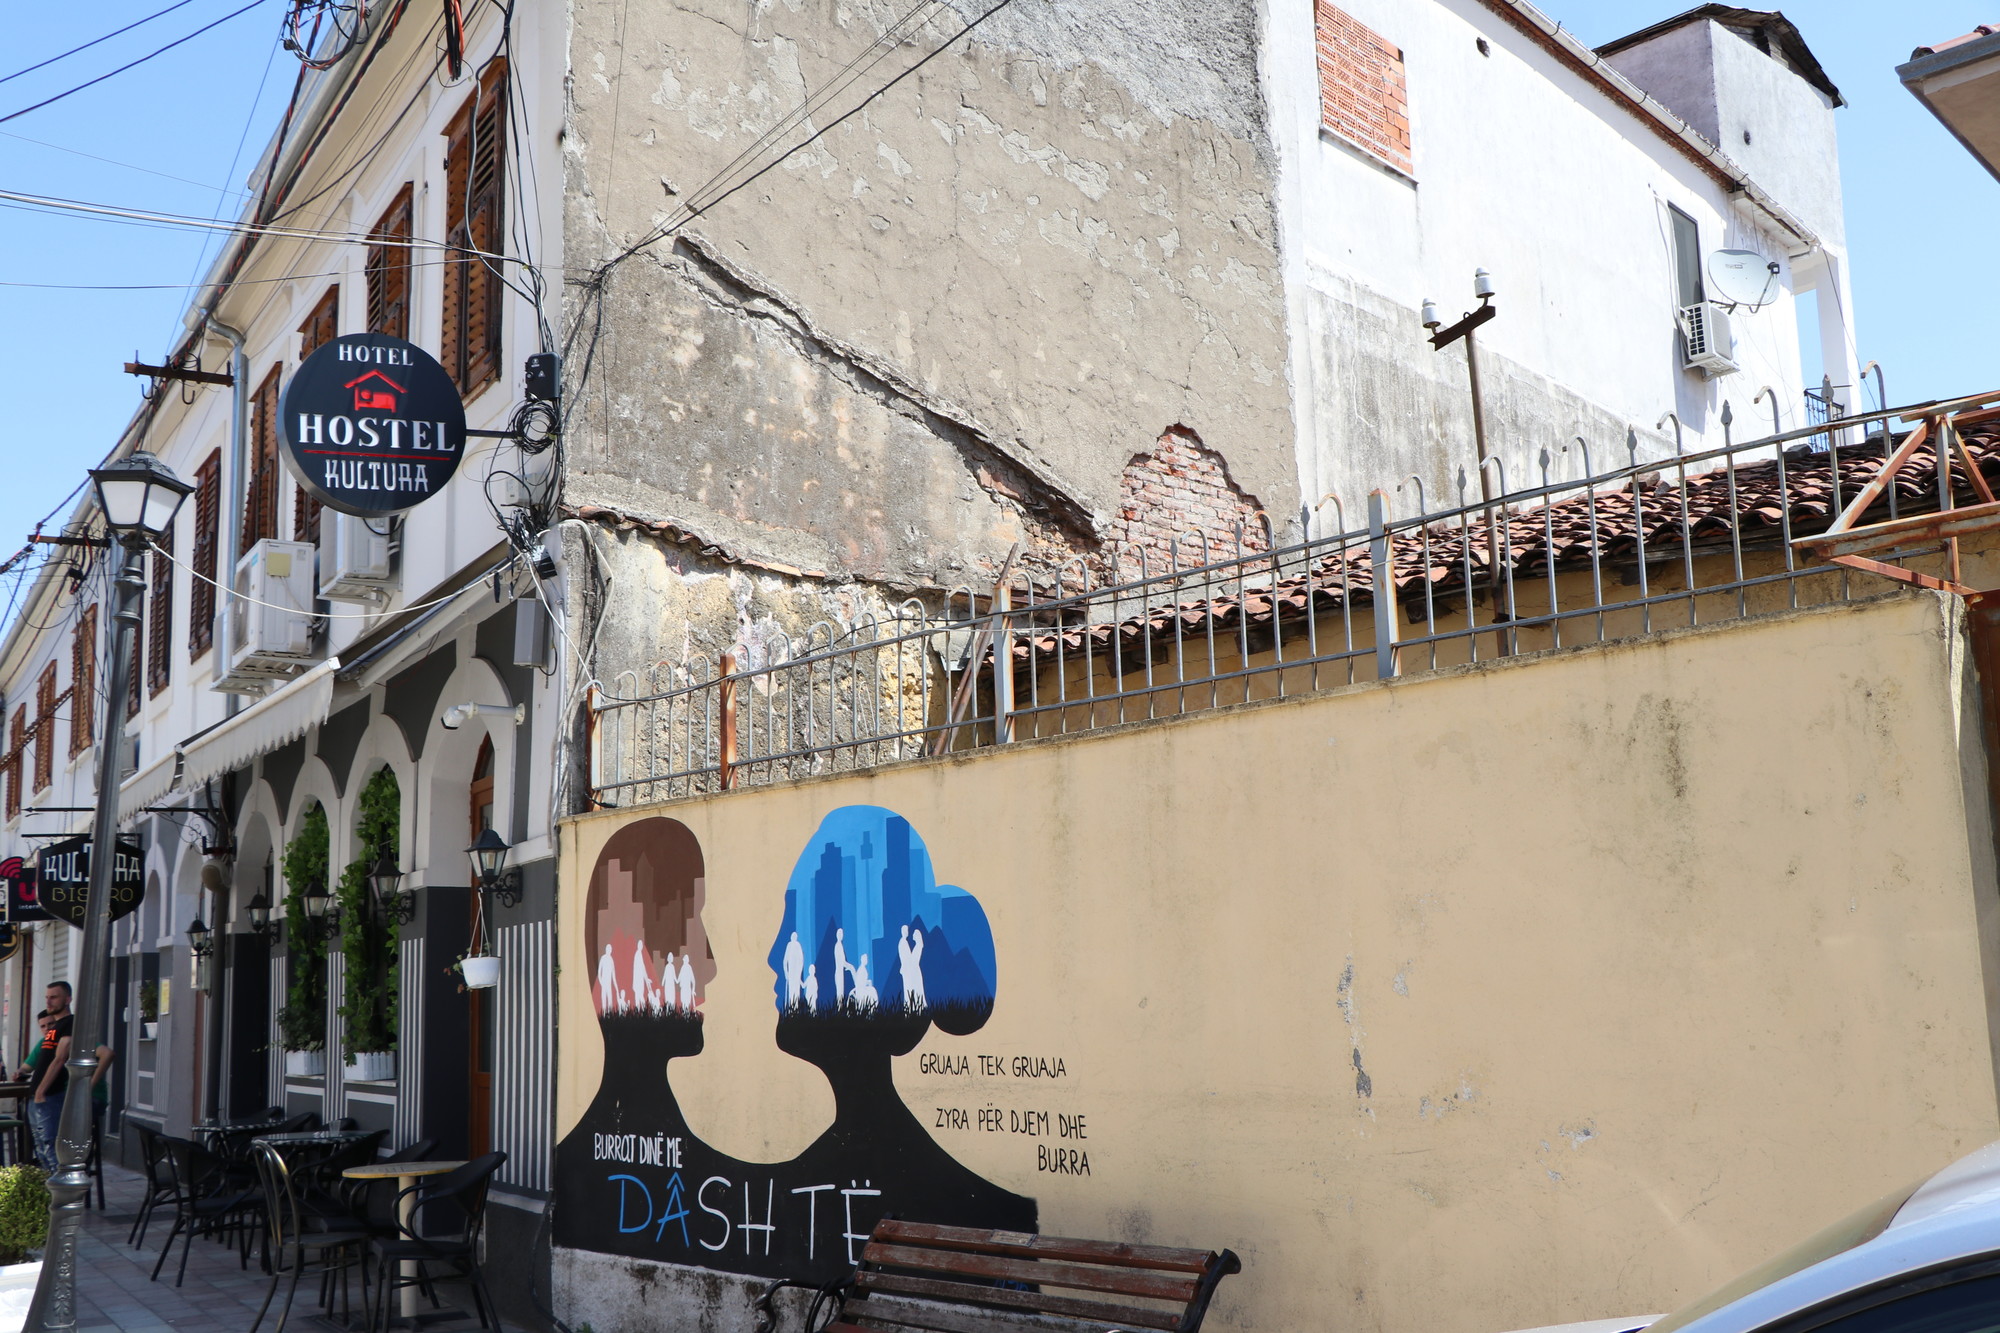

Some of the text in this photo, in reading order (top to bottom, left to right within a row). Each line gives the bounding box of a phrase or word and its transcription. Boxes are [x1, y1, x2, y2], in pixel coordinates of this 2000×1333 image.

[338, 343, 414, 366] HOTEL
[298, 412, 456, 452] HOSTEL
[325, 459, 429, 493] KULTURA
[44, 843, 141, 882] KULTRA
[52, 887, 134, 902] BISRO
[920, 1053, 1067, 1078] GRUAJA TEK GRUAJA
[935, 1102, 1088, 1140] ZYRA PËR DJEM DHE
[639, 1131, 664, 1167] DINË
[666, 1137, 683, 1168] ME
[1038, 1144, 1091, 1177] BURRA
